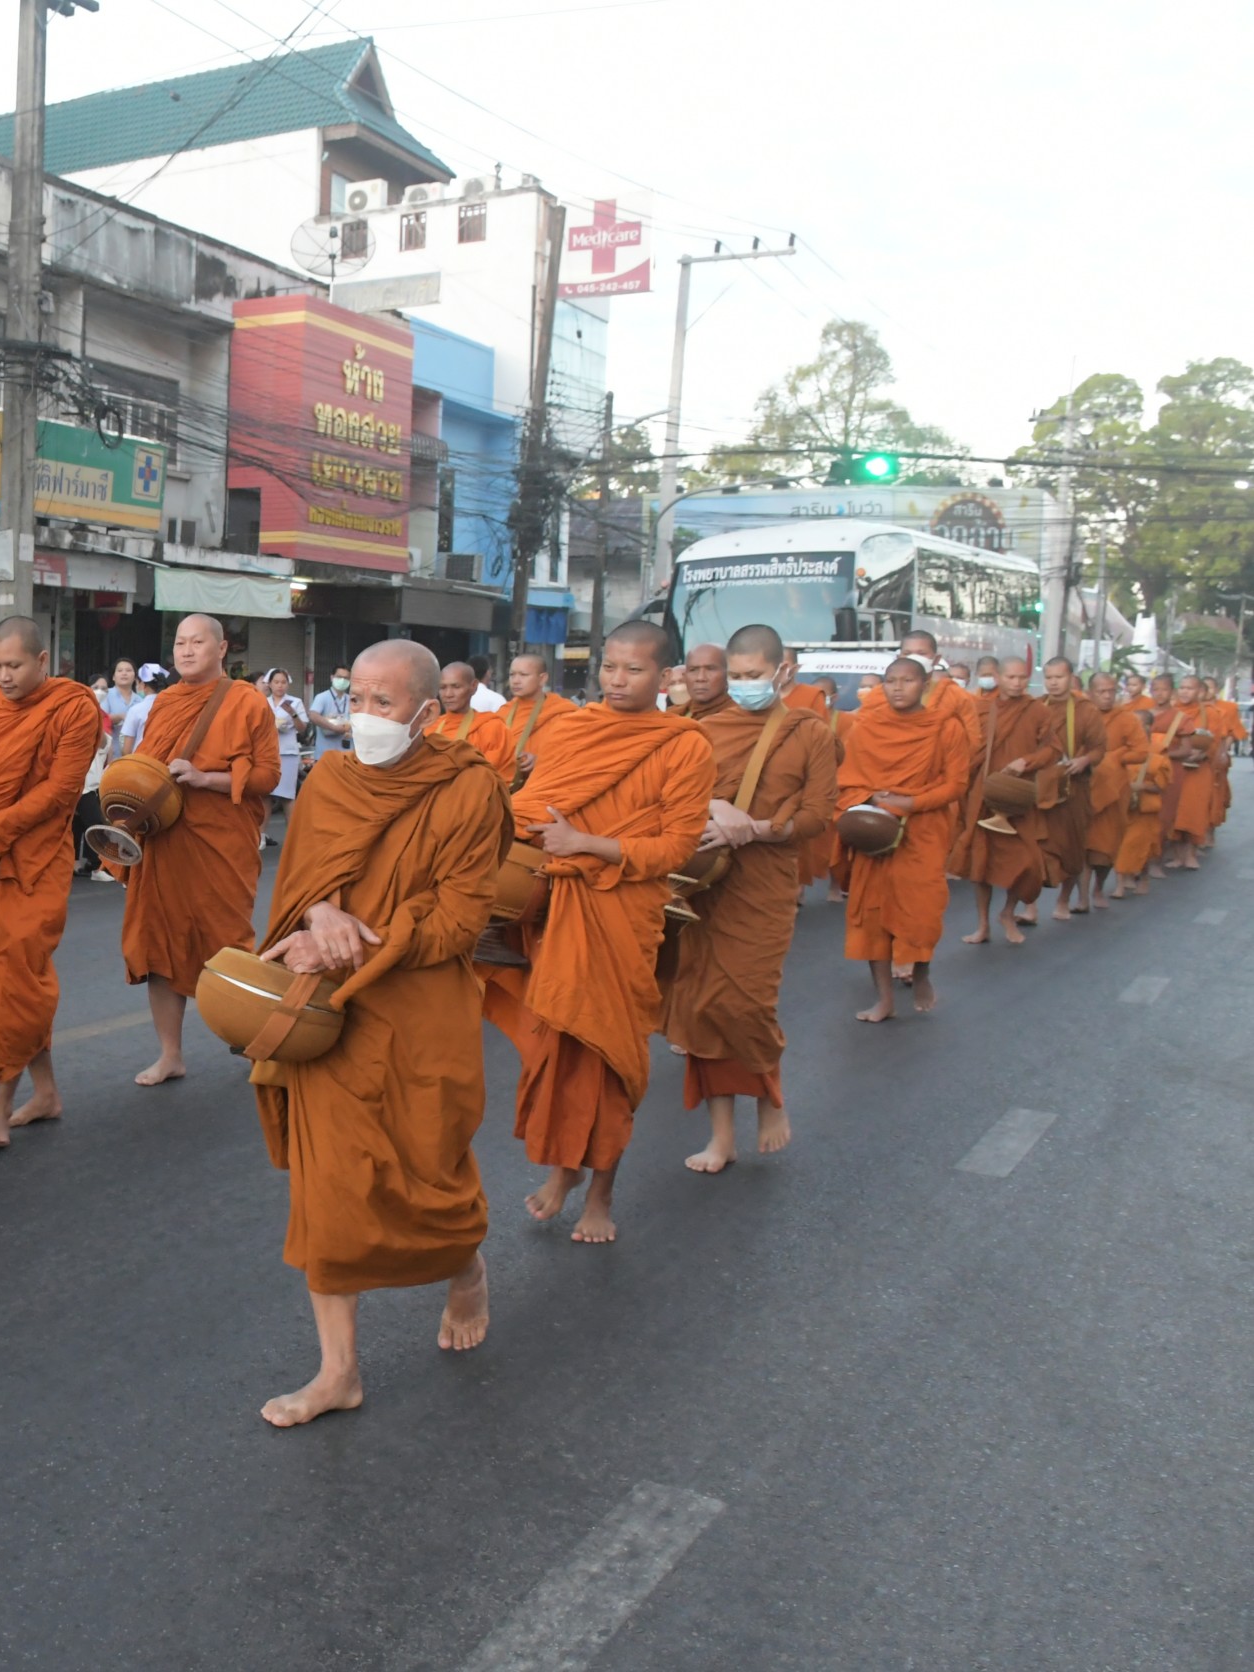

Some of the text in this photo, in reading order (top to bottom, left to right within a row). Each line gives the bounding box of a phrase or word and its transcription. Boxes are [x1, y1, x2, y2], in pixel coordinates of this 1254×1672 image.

[682, 556, 842, 583] โรงพยาบาลสรรพสิทธิประสงค์
